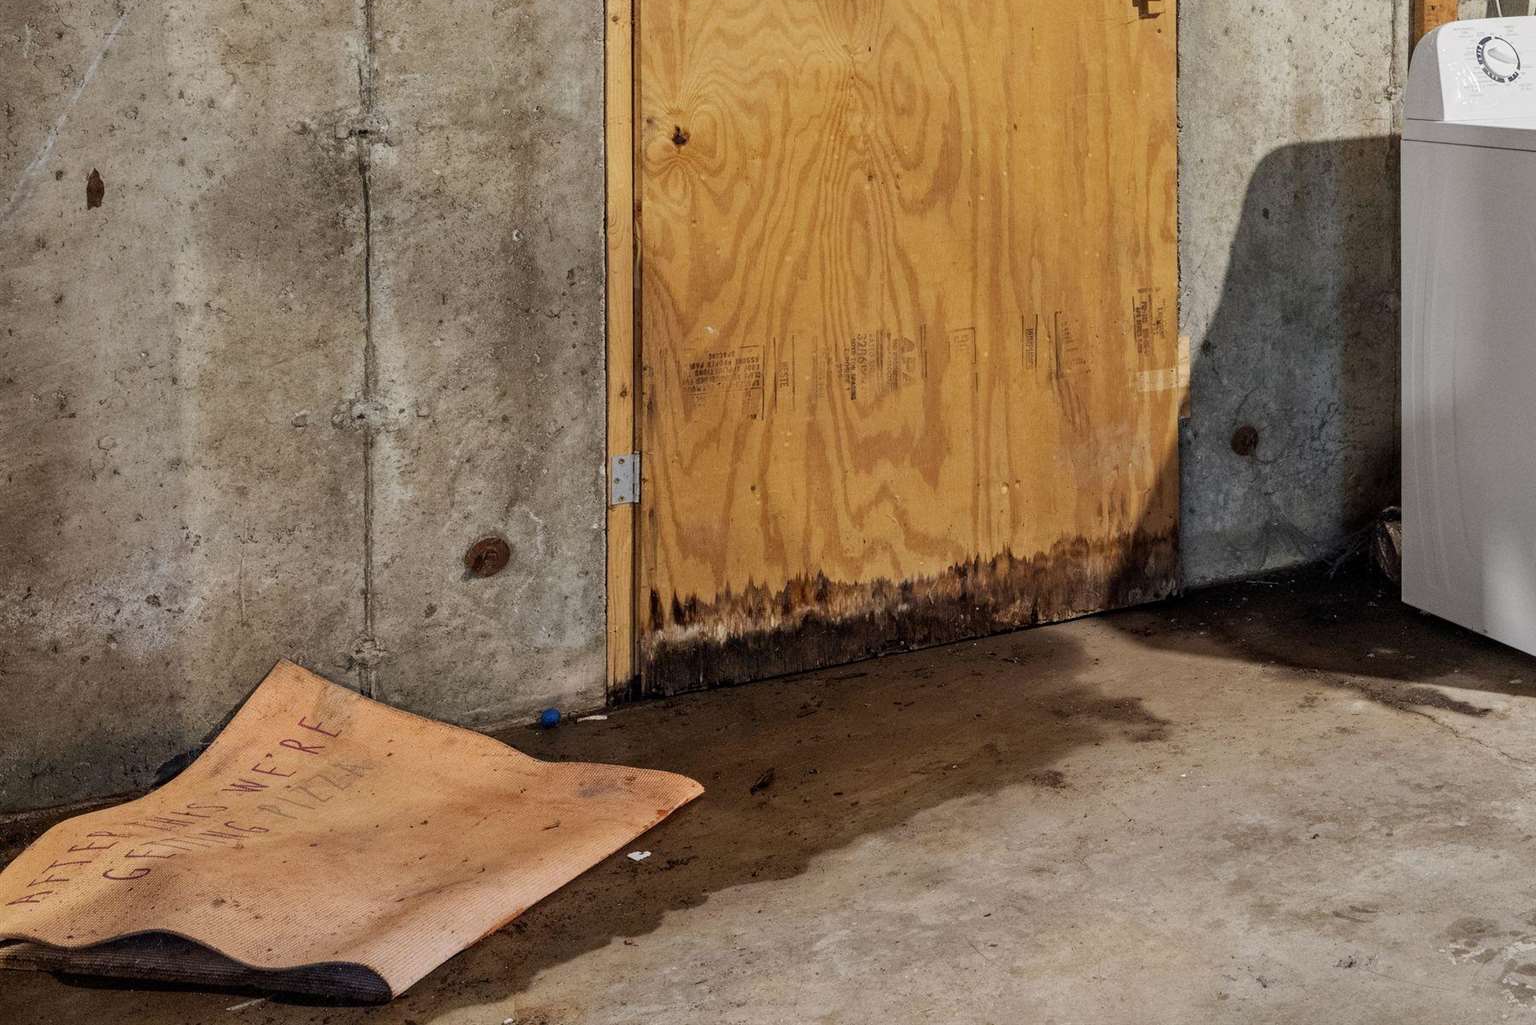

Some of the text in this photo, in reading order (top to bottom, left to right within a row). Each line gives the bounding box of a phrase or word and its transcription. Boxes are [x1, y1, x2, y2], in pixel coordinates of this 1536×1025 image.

[5, 831, 129, 906] AFTER
[221, 716, 343, 792] WE'RE
[102, 821, 270, 880] GETTING
